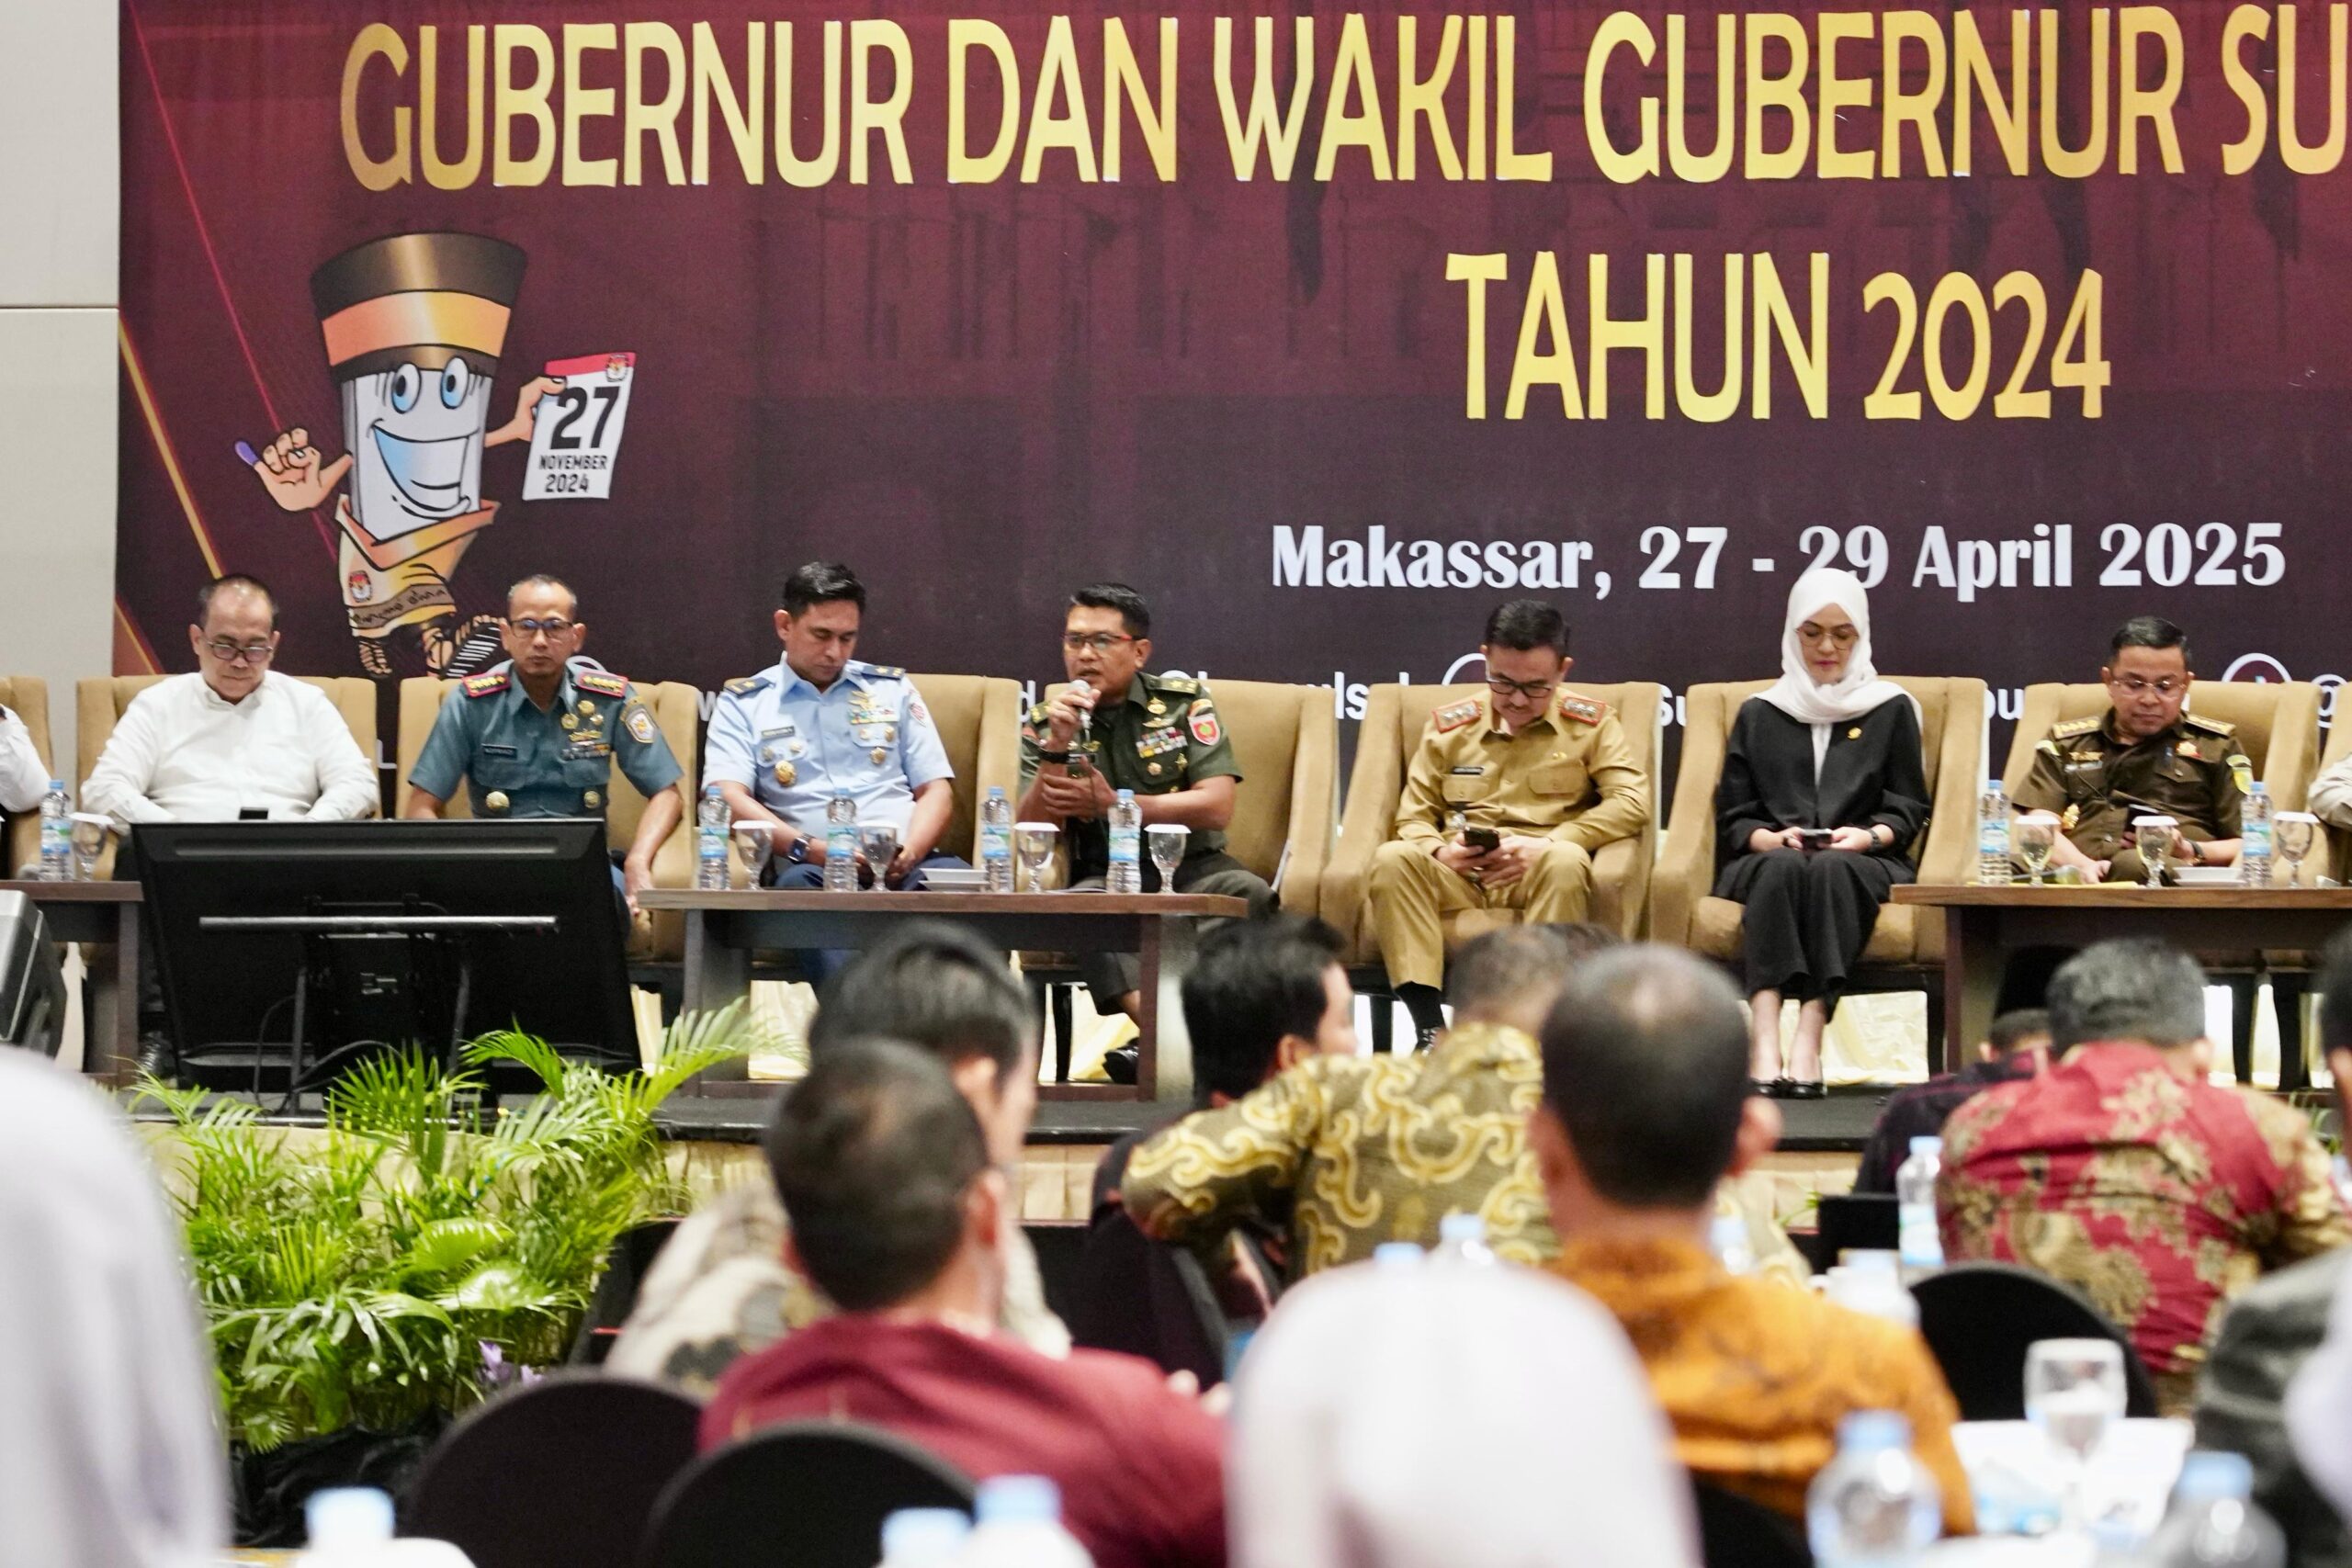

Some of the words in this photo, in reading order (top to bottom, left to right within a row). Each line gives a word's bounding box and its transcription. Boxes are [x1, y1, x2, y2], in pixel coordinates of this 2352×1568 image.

[340, 18, 914, 191] GUBERNUR
[946, 15, 1180, 185] DAN
[1213, 12, 1554, 183] WAKIL
[1583, 6, 2186, 184] GUBERNUR
[2221, 2, 2349, 176] SU
[1444, 250, 1830, 423] TAHUN
[1862, 268, 2111, 422] 2024
[549, 386, 620, 450] 27
[539, 455, 608, 469] NOVEMBER
[545, 473, 588, 492] 2024
[1272, 525, 1611, 601] Makassar,
[1638, 525, 1728, 590] 27
[1752, 558, 1775, 572] -
[1799, 525, 1889, 589] 29
[1912, 523, 2072, 603] April
[2099, 522, 2286, 587] 2025
